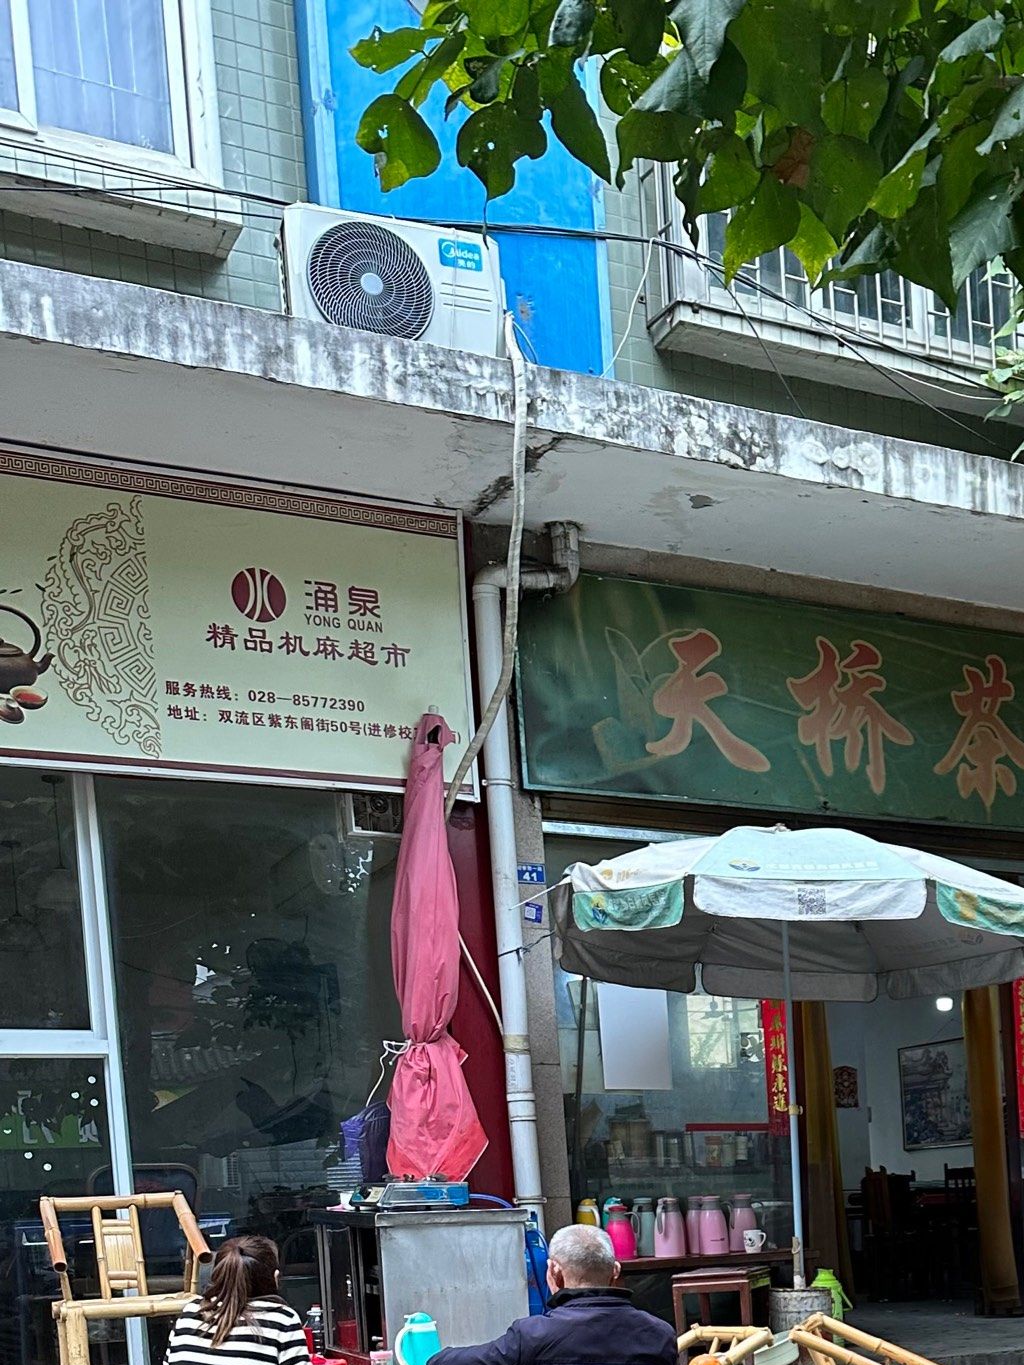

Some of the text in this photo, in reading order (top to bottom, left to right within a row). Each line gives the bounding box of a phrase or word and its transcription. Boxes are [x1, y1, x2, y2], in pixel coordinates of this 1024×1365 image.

[304, 579, 381, 618] 涌泉
[304, 613, 383, 633] YONG QUAN
[206, 622, 411, 668] 精品机麻超市
[523, 871, 538, 882] 41
